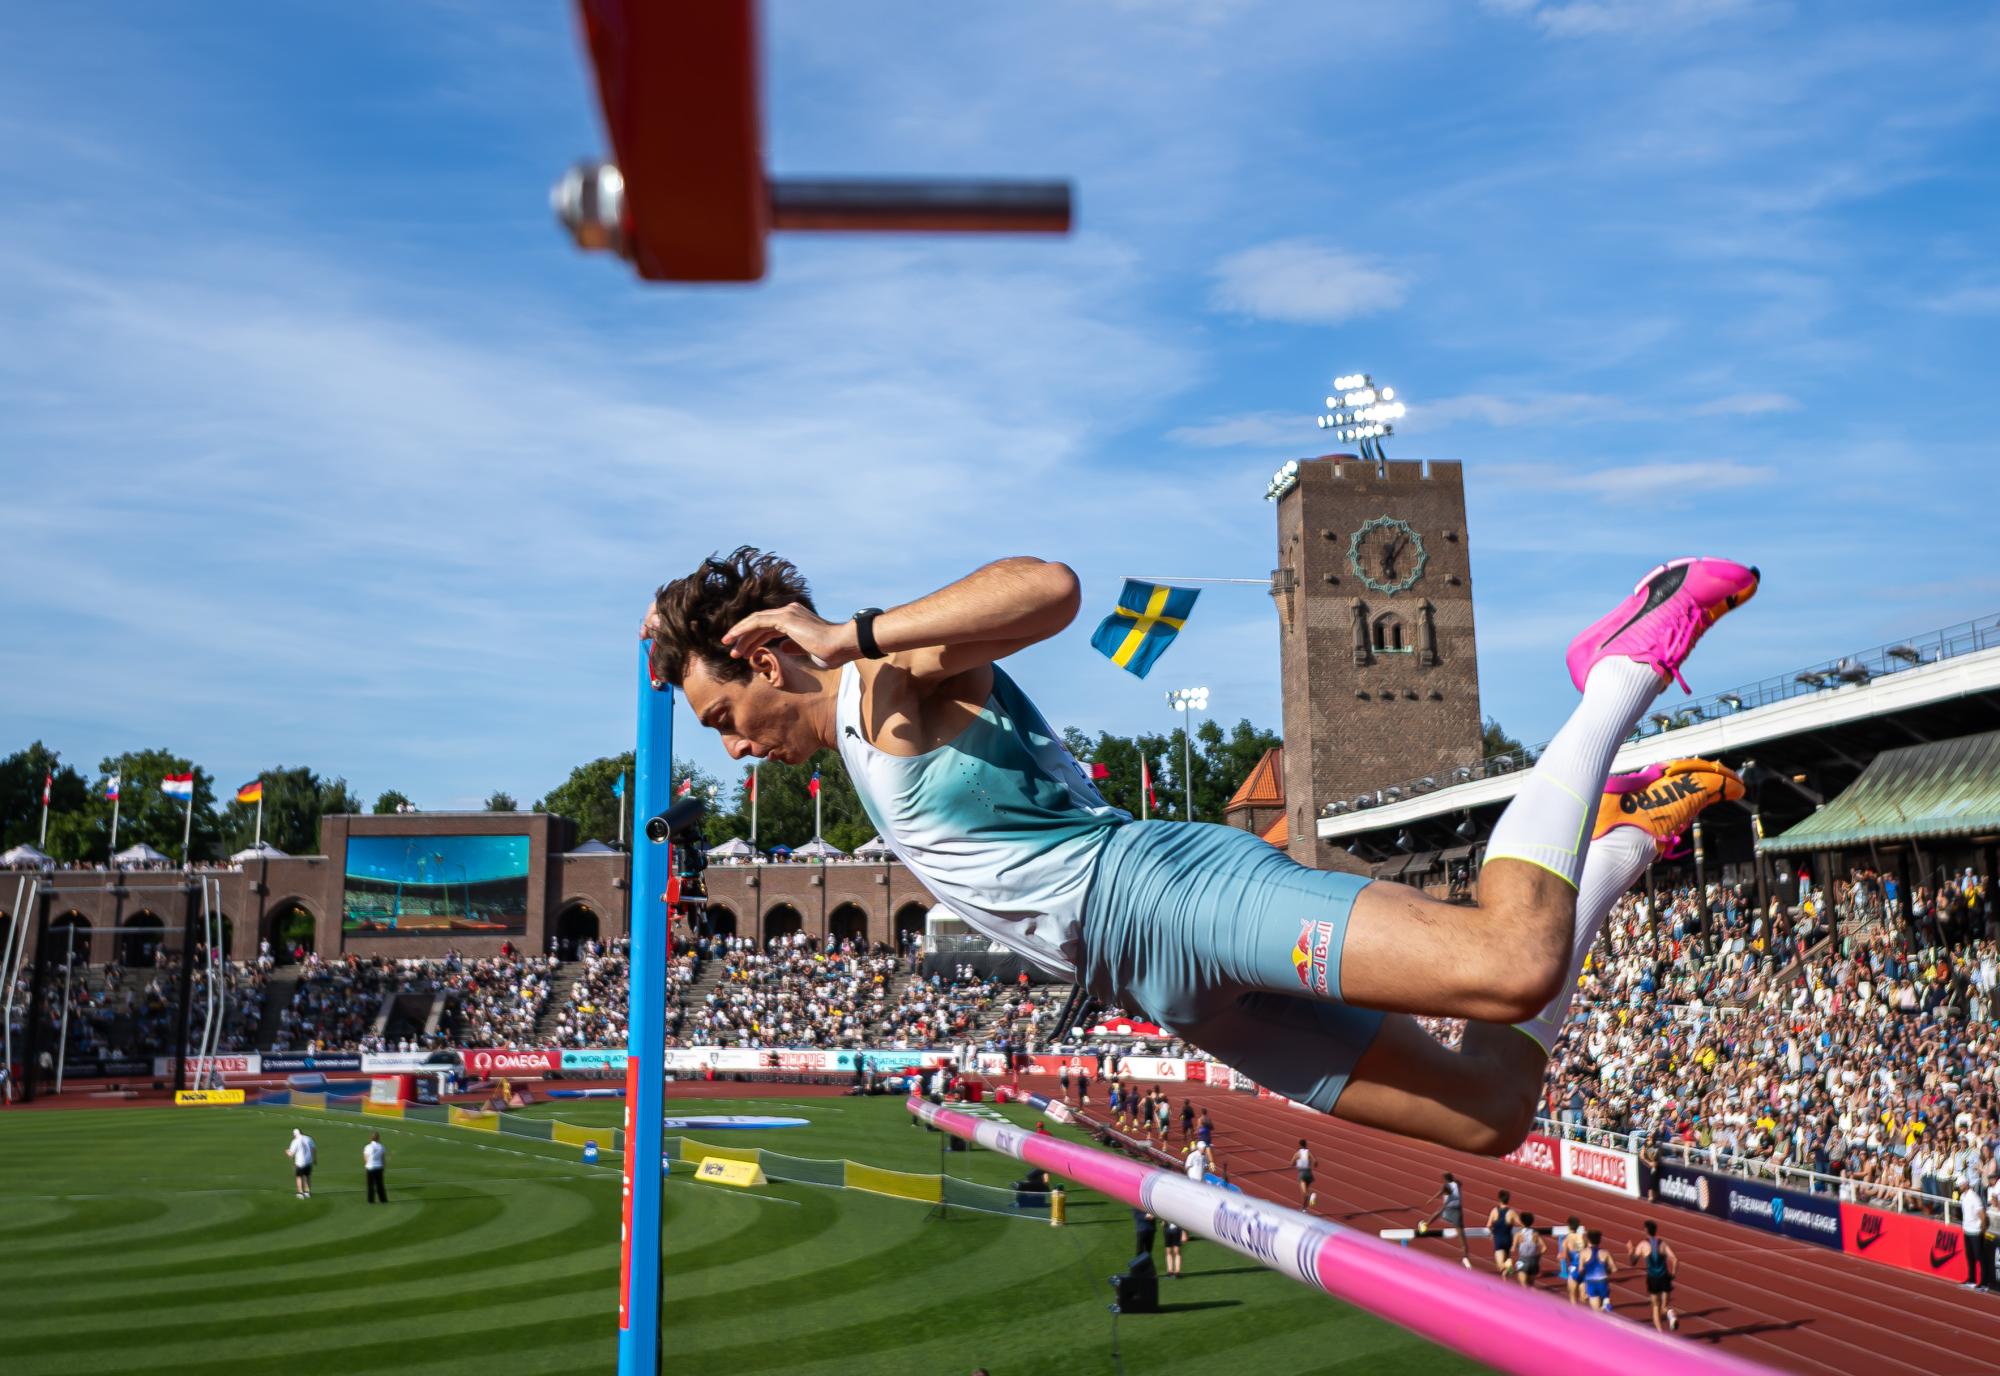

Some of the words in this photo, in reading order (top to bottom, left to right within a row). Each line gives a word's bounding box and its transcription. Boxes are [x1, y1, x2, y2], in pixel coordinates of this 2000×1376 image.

[1619, 772, 1706, 815] NITRO
[1314, 921, 1333, 959] Bull
[1314, 958, 1328, 995] Red
[495, 1054, 550, 1068] OMEGA
[759, 1053, 826, 1067] BUHAUS
[1157, 1062, 1176, 1077] ICA
[1570, 1146, 1627, 1190] BAUHAUS
[1860, 1213, 1883, 1234] RUN
[1935, 1230, 1958, 1251] RUN
